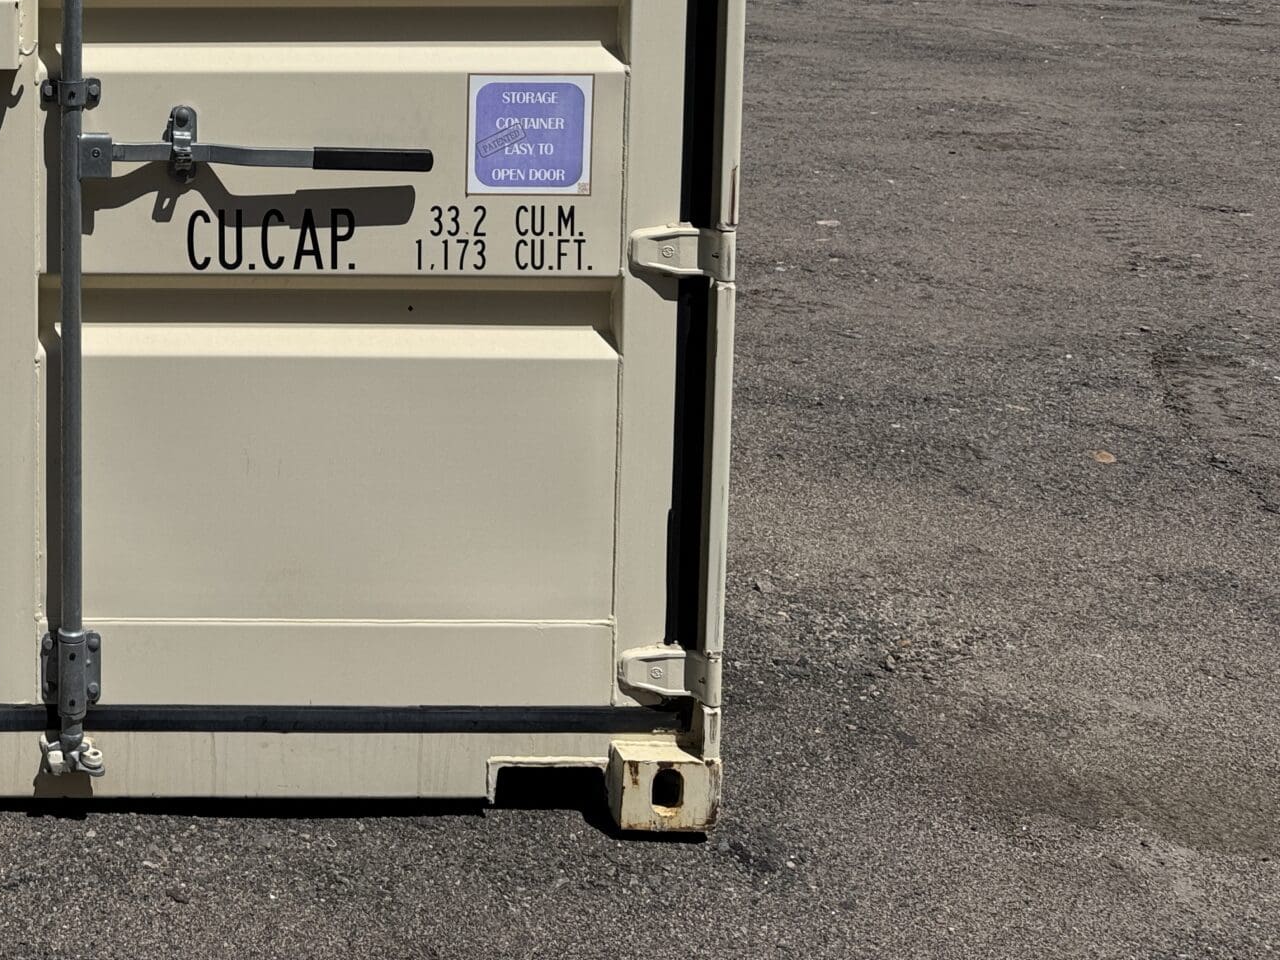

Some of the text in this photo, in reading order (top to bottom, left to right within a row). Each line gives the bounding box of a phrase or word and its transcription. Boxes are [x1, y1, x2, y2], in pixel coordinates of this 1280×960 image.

[502, 92, 558, 104] STORAGE
[496, 117, 565, 130] CONTAINER
[481, 129, 520, 154] PATENTED
[505, 143, 553, 155] EASY TO
[492, 168, 565, 181] OPEN DOOR
[187, 208, 356, 270] CU.CAP.
[515, 205, 584, 237] CU.M.
[415, 239, 593, 271] 1,173 CU.FT.
